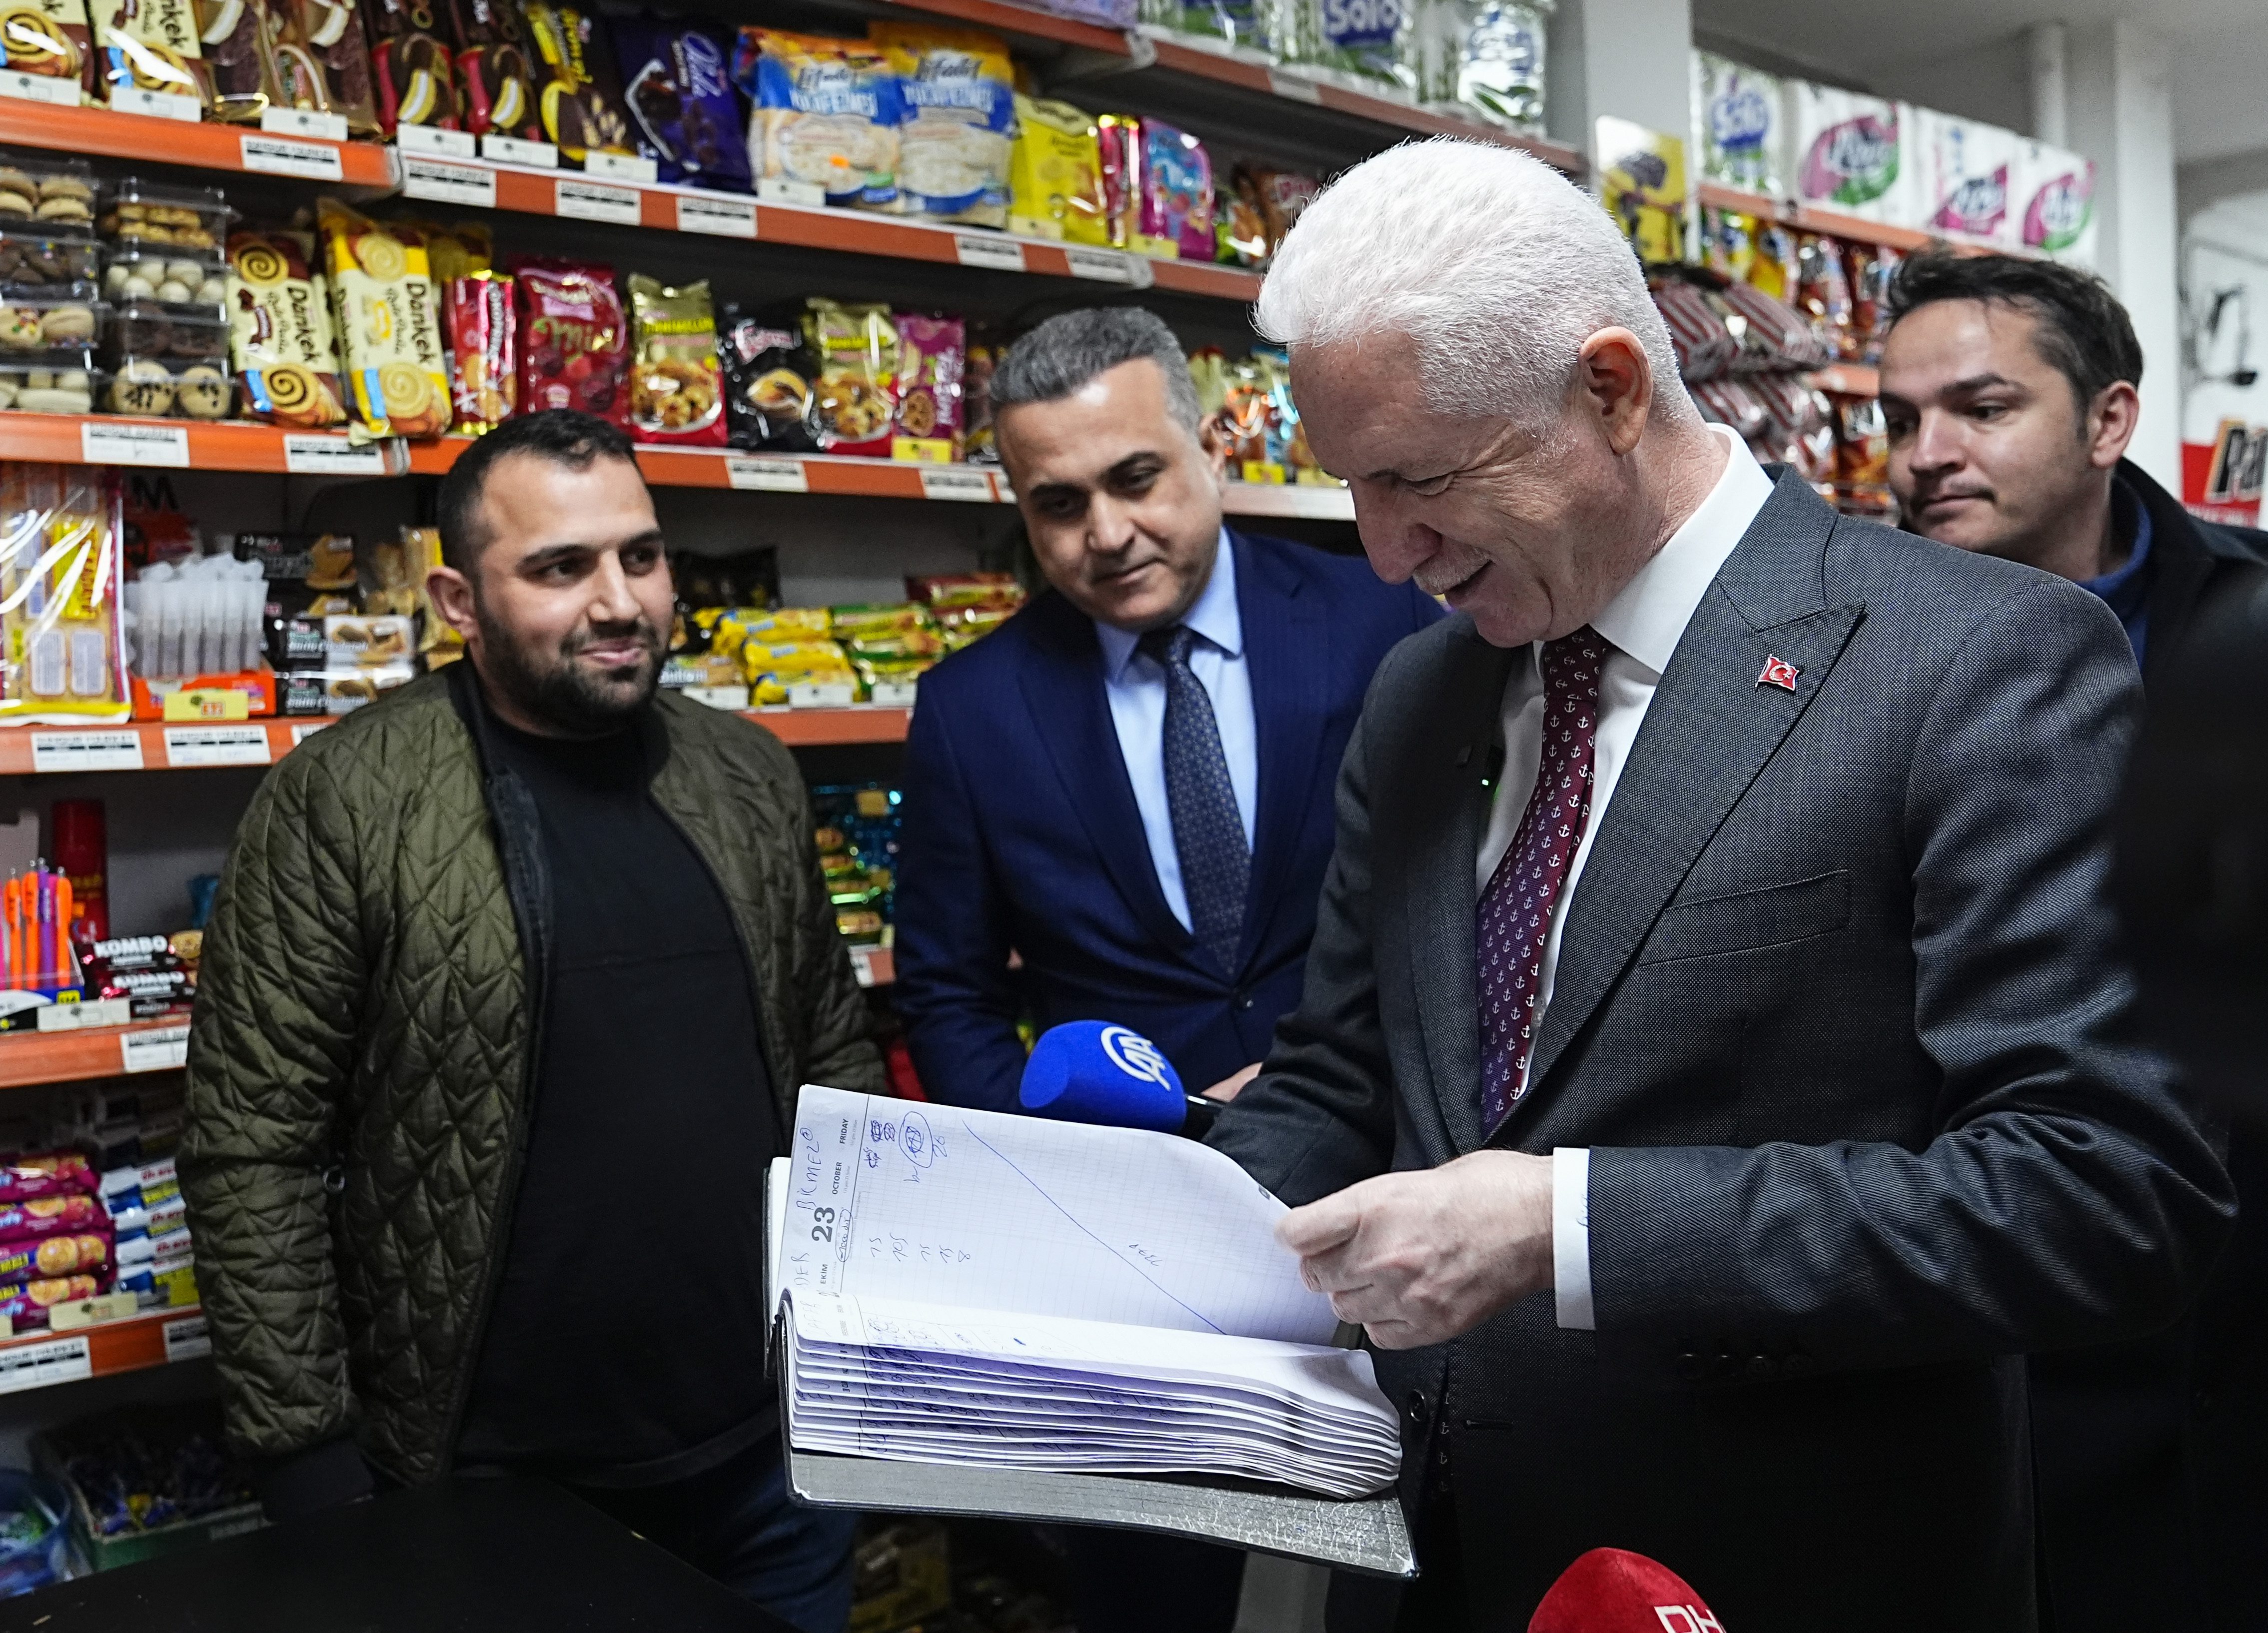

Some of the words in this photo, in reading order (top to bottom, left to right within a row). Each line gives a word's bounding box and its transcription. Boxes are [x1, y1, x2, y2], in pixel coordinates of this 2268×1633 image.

[812, 1207, 835, 1242] 23
[832, 1162, 843, 1194] OCTOBER
[840, 1118, 849, 1144] FRIDAY
[869, 1238, 882, 1258] 15
[889, 1232, 909, 1262] 105
[920, 1244, 932, 1262] 15
[939, 1245, 954, 1263] 15
[958, 1250, 971, 1262] 8
